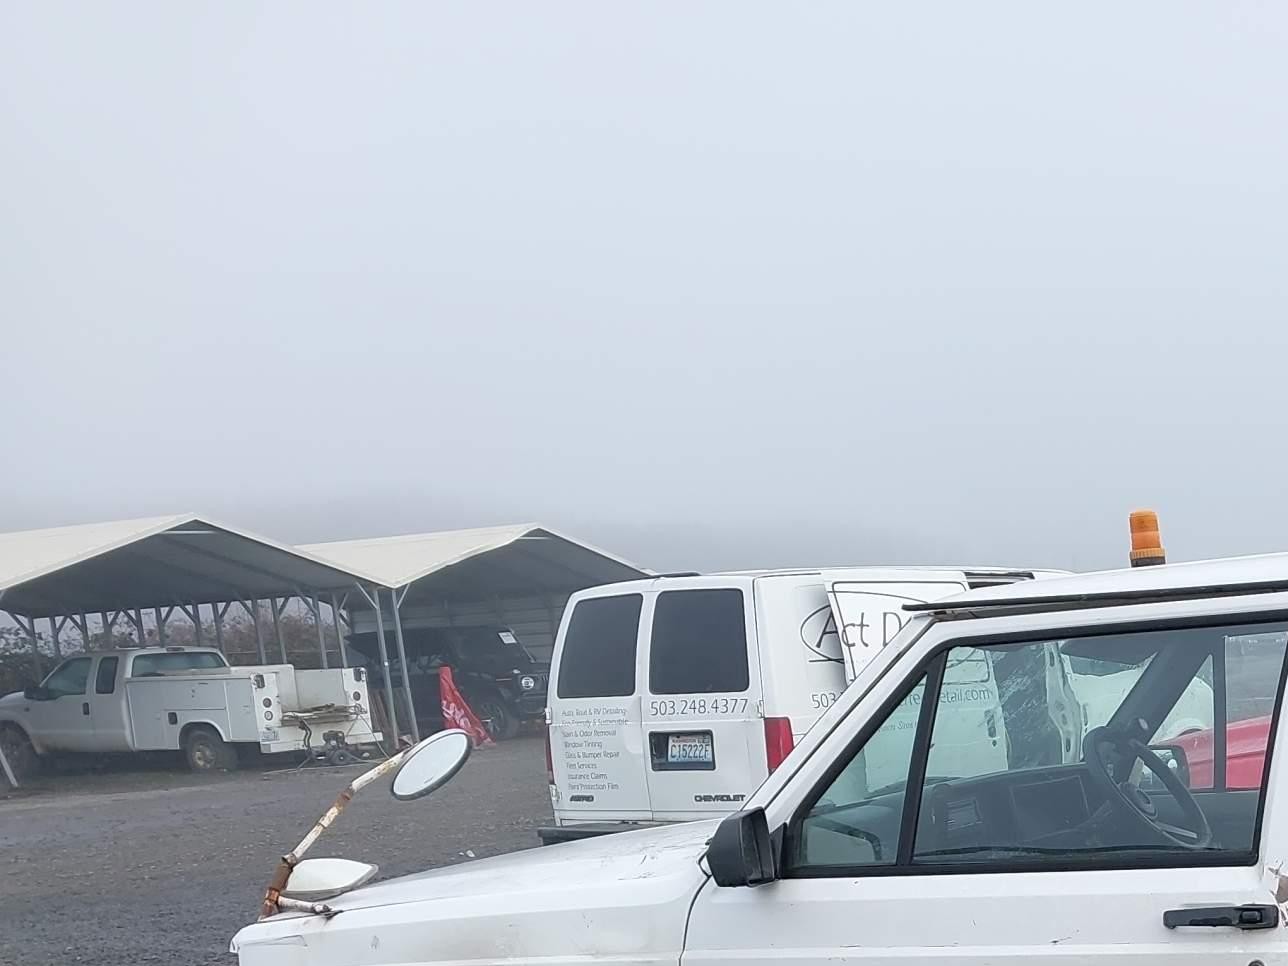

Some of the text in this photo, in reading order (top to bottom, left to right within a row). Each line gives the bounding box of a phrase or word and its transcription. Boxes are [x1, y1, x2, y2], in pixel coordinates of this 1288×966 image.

[815, 609, 870, 649] Act
[650, 698, 749, 716] 503.248.4377
[811, 691, 839, 709] 503
[694, 794, 746, 803] CHEVROLET
